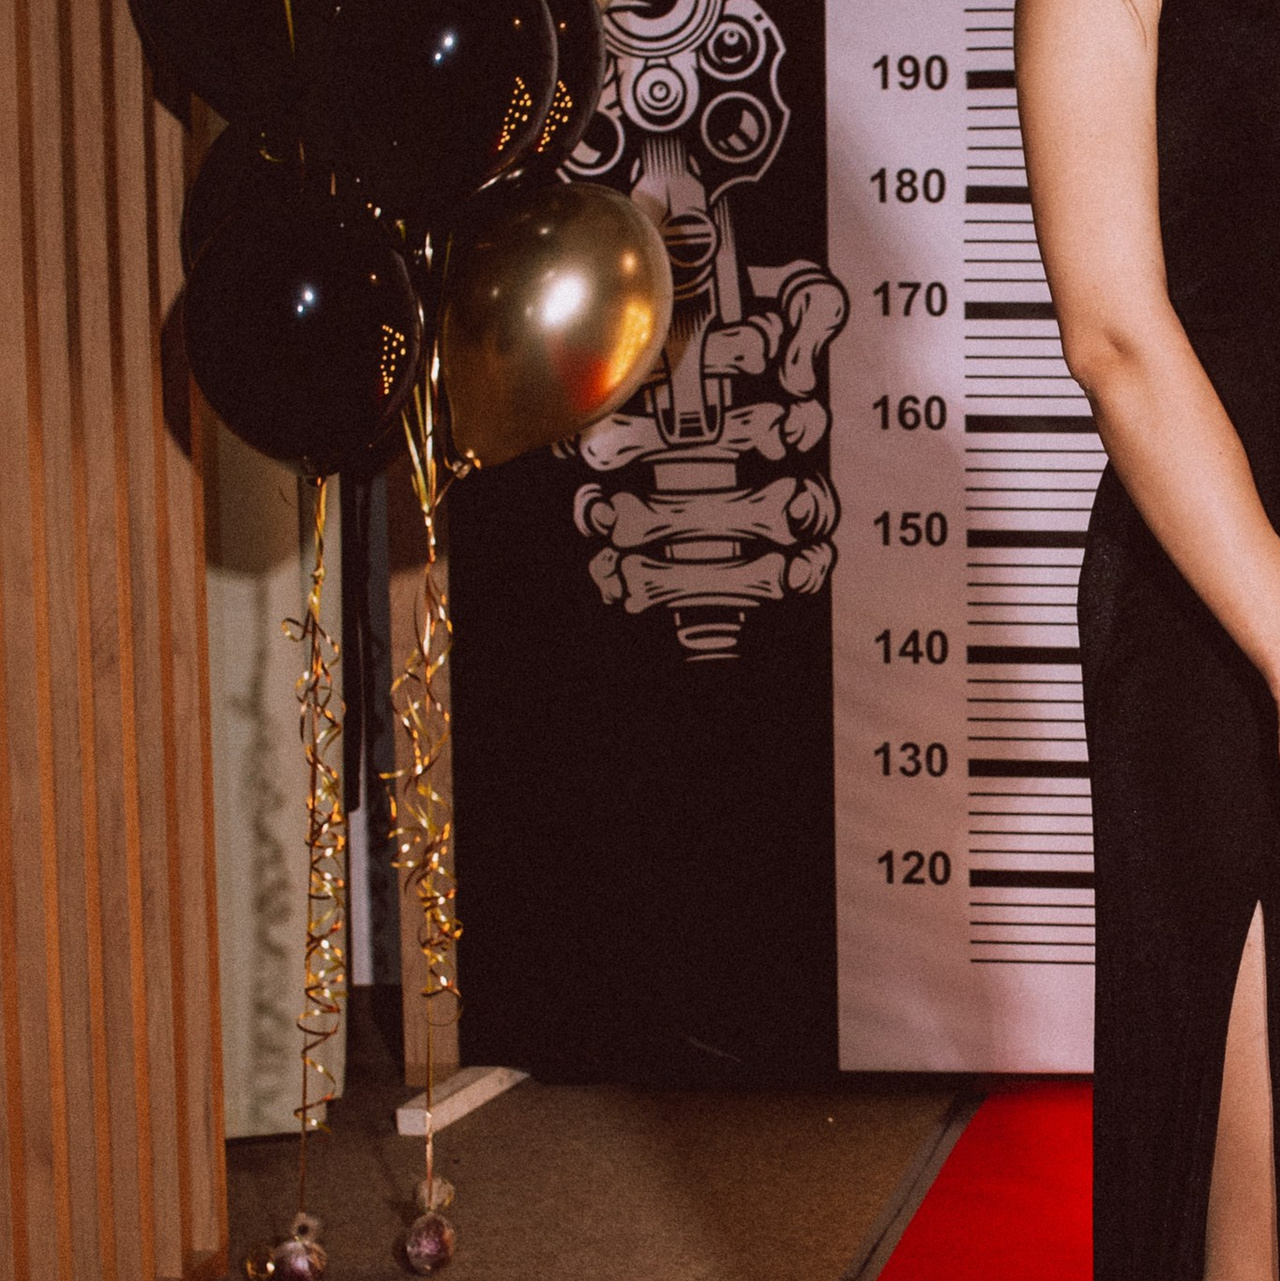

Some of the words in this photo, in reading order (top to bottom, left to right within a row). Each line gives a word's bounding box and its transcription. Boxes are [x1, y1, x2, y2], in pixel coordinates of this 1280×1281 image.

[872, 54, 950, 91] 190
[869, 167, 947, 204] 180
[872, 281, 949, 318] 170
[872, 394, 949, 432] 160
[873, 510, 949, 548] 150
[874, 628, 950, 666] 140
[873, 741, 950, 778] 130
[877, 849, 953, 887] 120
